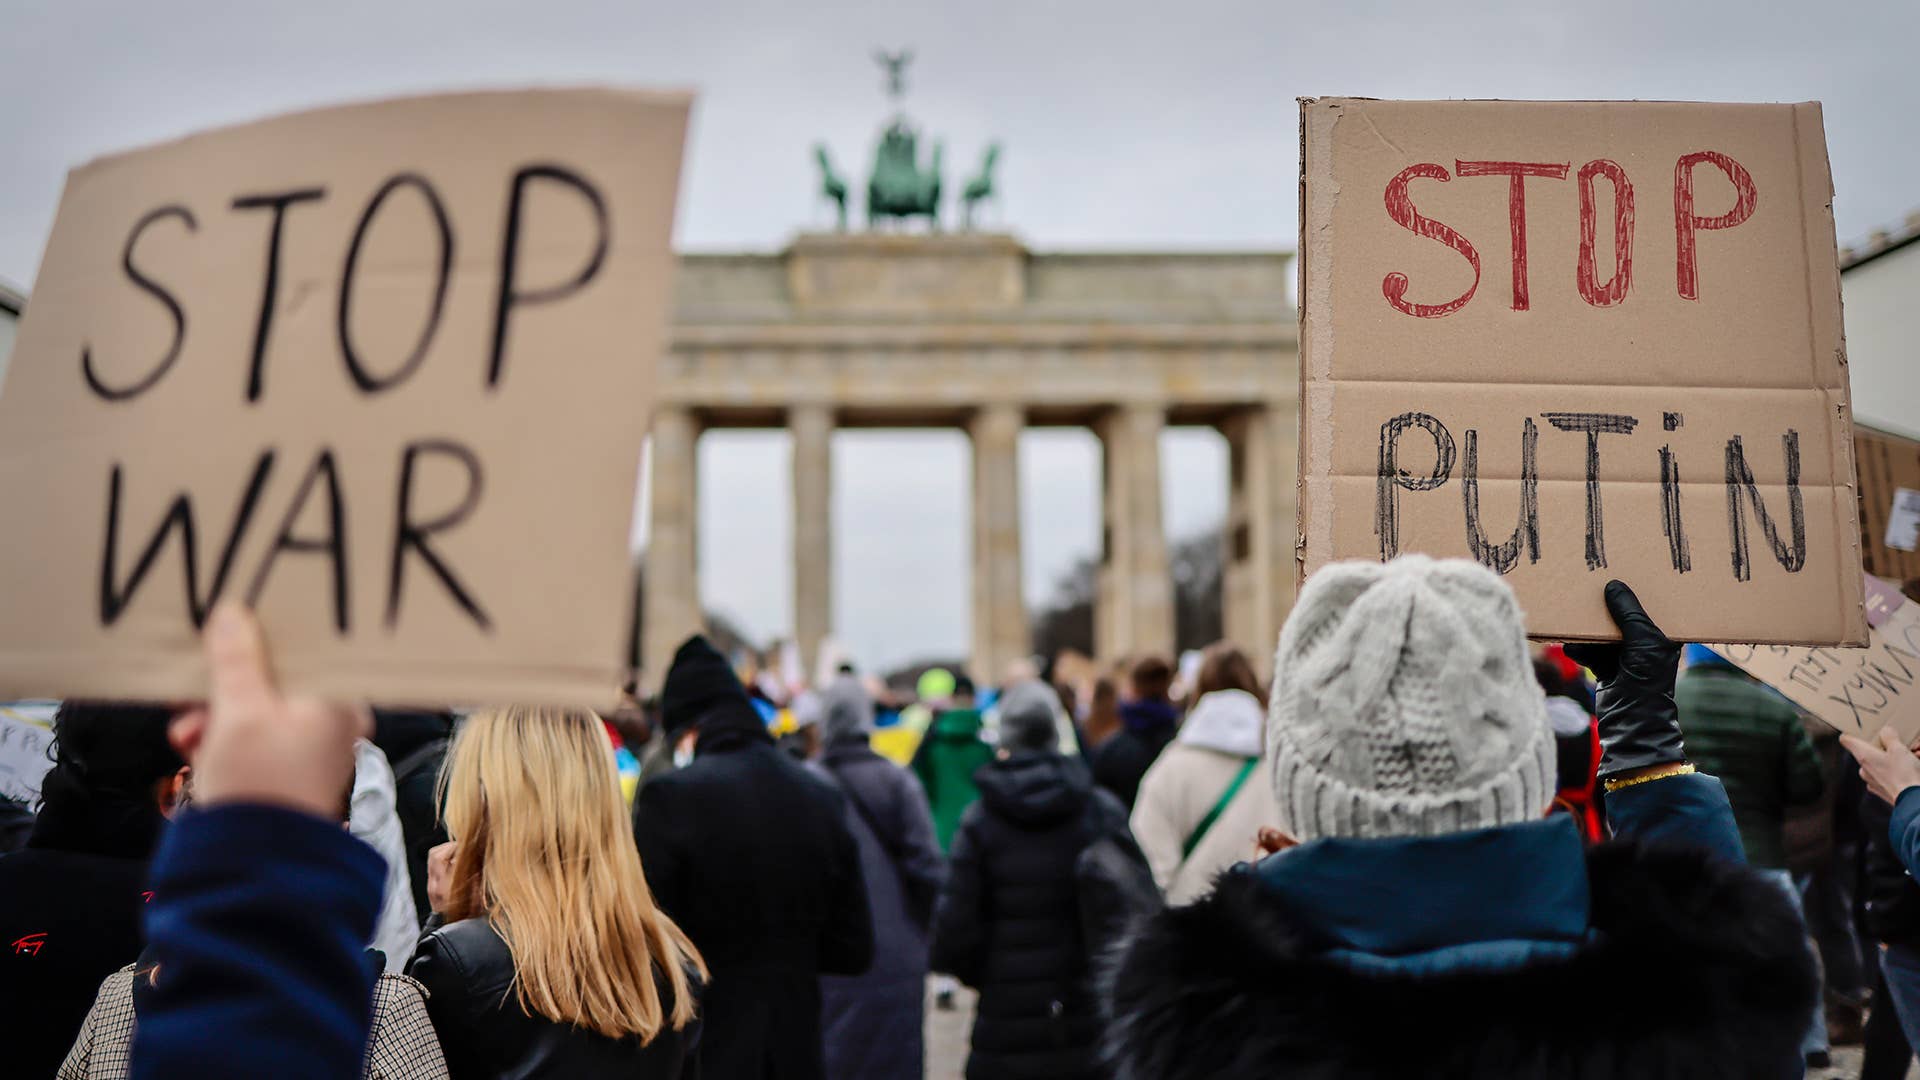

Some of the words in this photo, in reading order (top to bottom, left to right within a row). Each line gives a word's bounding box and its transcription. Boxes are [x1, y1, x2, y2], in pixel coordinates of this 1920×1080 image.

[82, 162, 611, 404] STOP
[1382, 151, 1758, 318] STOP
[97, 438, 496, 635] WAR
